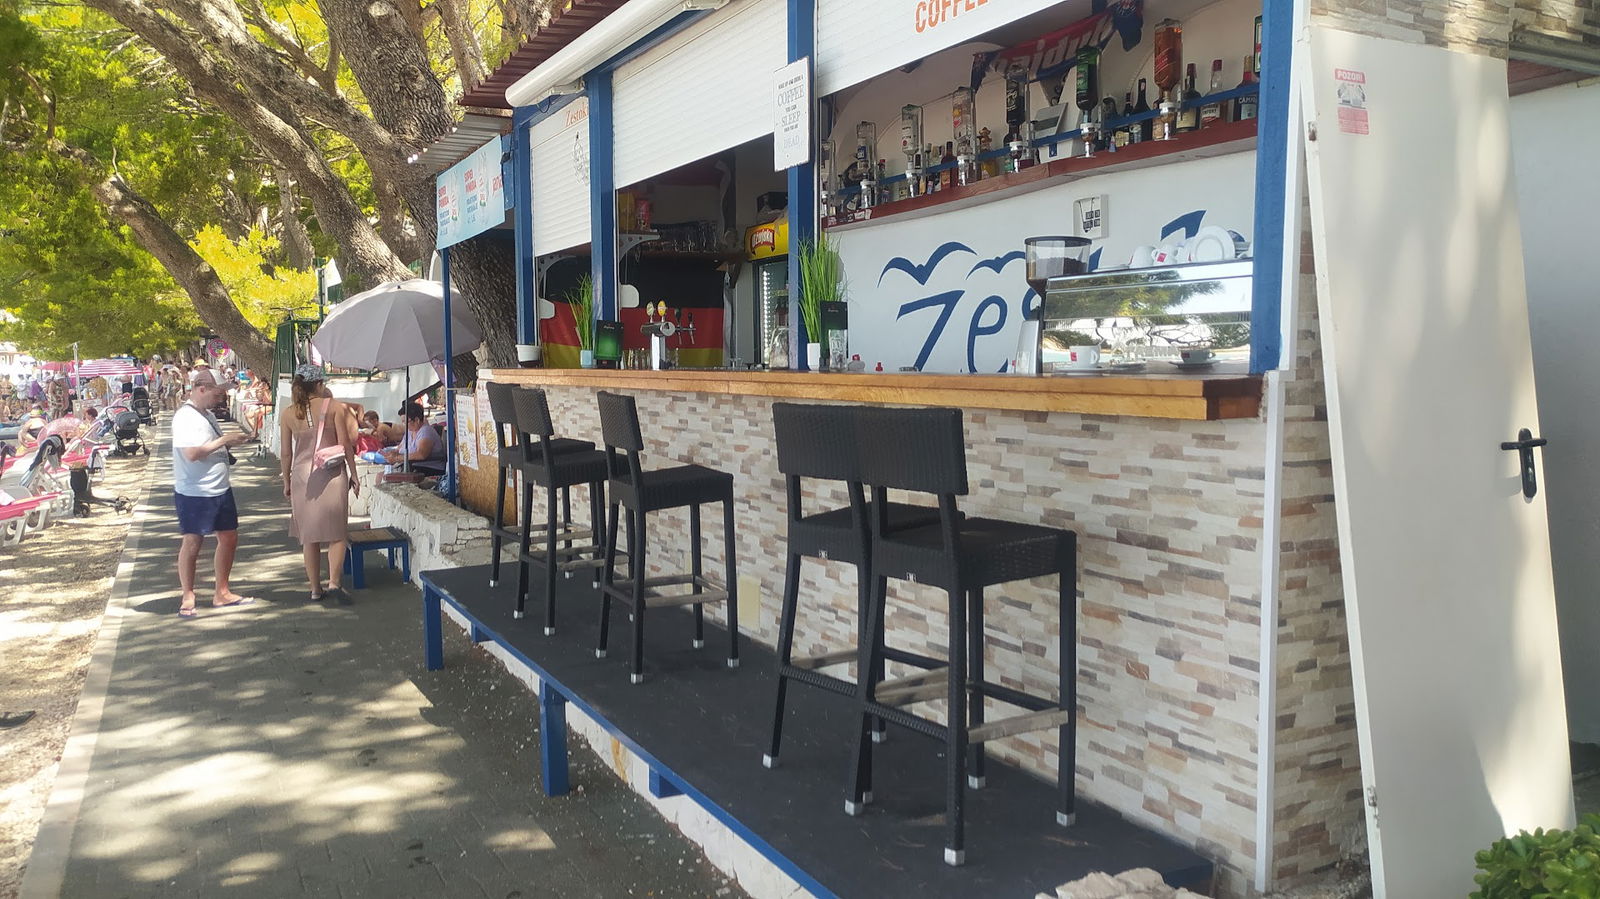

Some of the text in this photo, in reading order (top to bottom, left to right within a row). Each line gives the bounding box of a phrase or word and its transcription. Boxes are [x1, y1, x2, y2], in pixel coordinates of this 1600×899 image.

[914, 0, 988, 33] COFF
[778, 85, 804, 107] COFFEE
[565, 101, 589, 127] Zestok
[782, 111, 800, 127] SLEEP
[784, 135, 799, 149] DEAD
